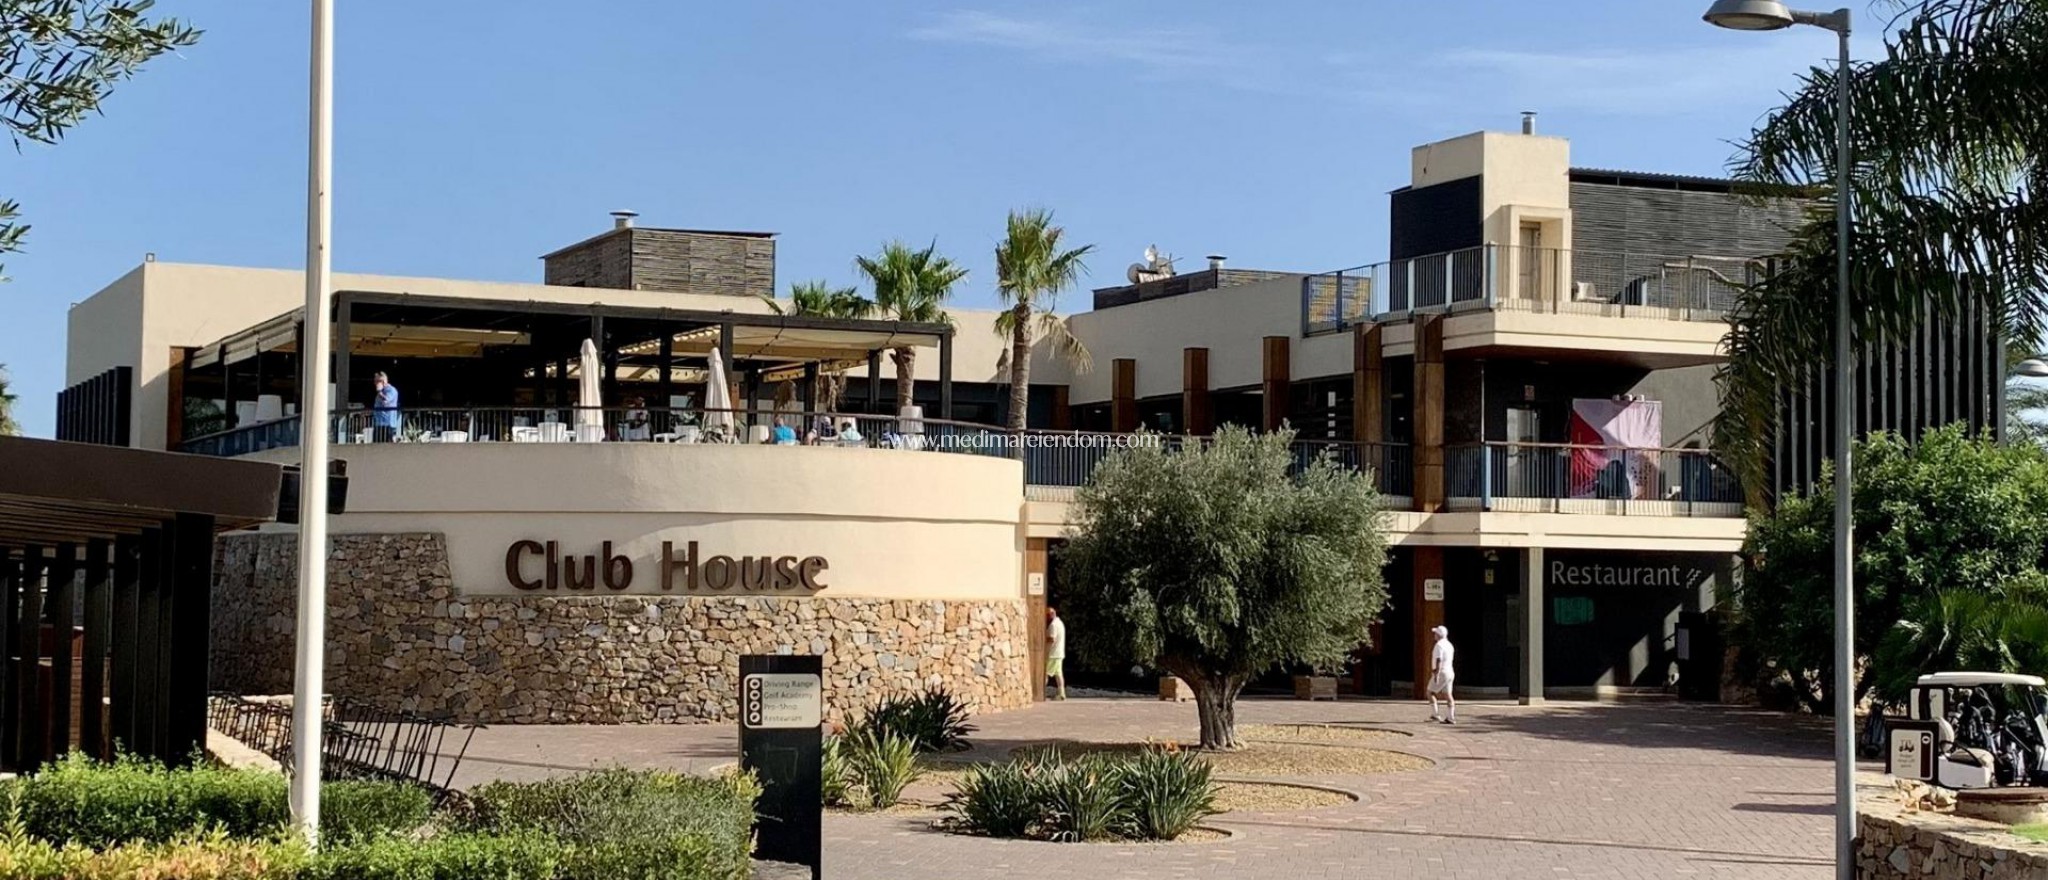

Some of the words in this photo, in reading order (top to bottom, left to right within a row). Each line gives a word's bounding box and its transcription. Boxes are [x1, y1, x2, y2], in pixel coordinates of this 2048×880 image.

[505, 539, 633, 591] Club
[661, 540, 829, 591] House
[1551, 560, 1681, 586] Restaurant
[763, 691, 779, 699] Golf
[781, 691, 813, 699] Academy
